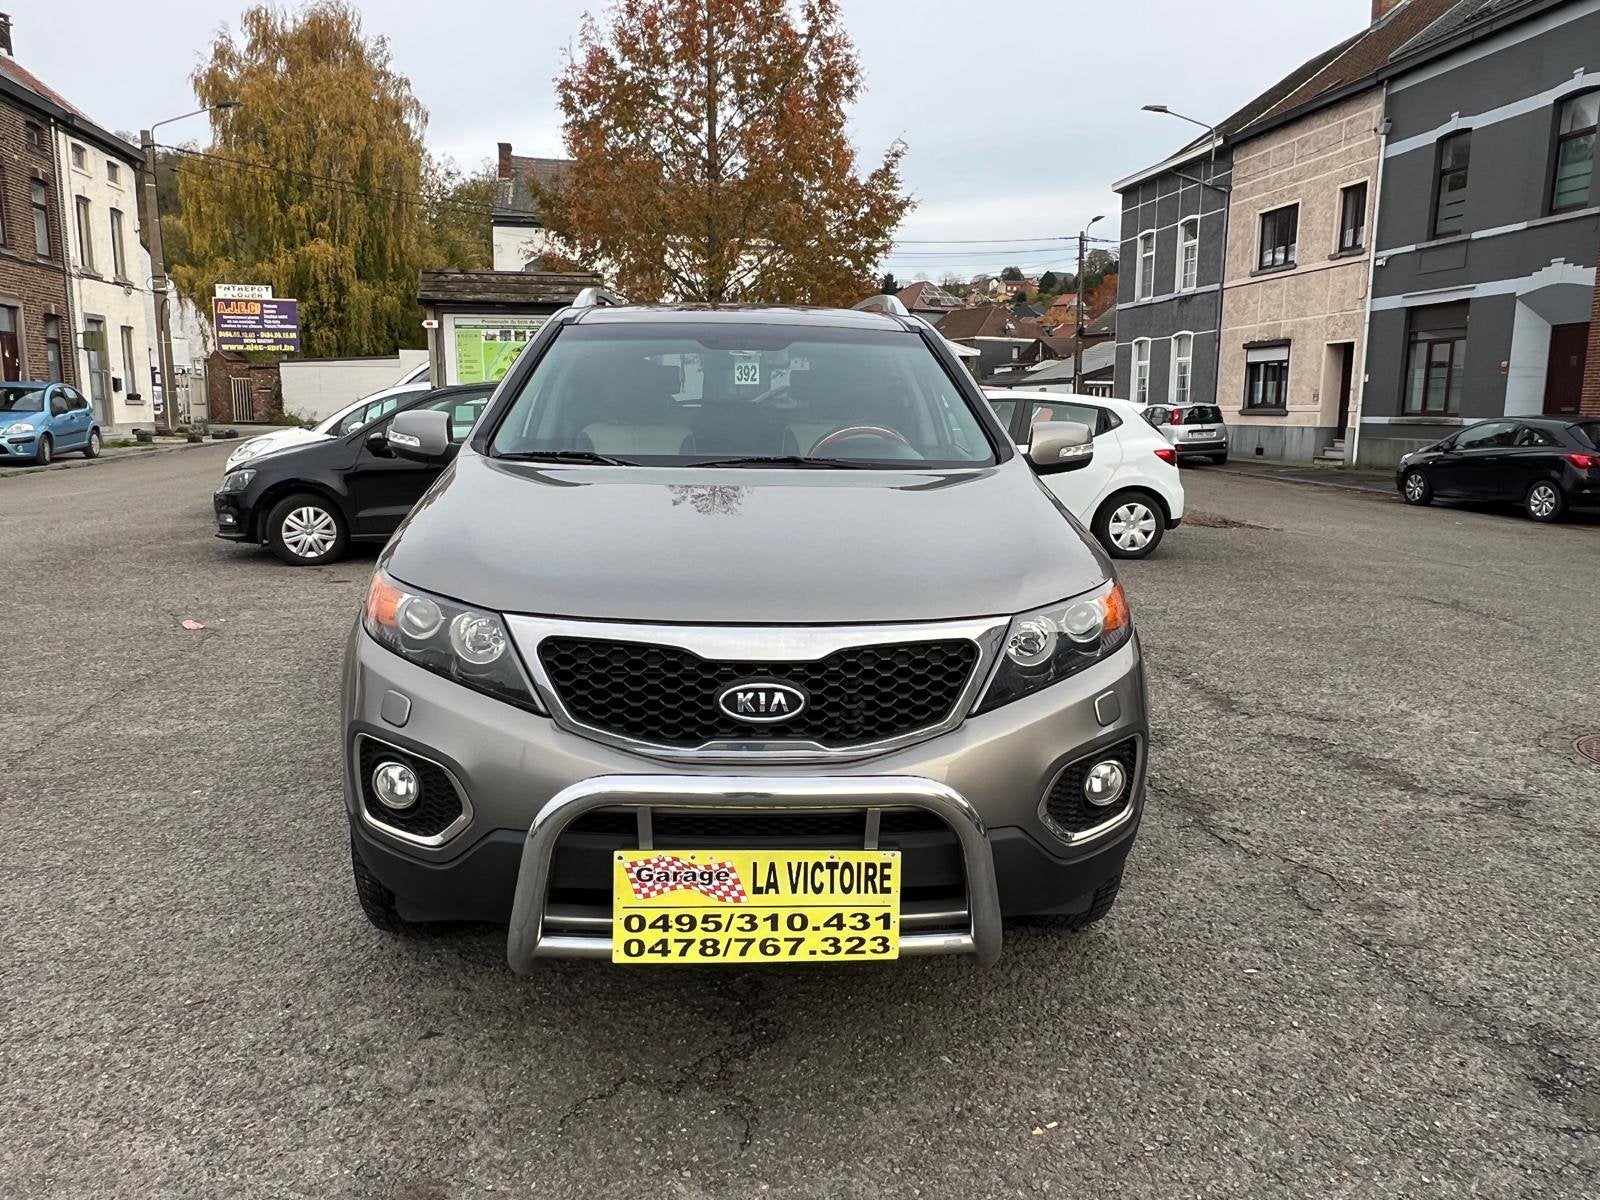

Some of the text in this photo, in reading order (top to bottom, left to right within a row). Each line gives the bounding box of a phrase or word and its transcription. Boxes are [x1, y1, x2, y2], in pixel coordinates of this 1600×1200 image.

[736, 365, 757, 382] 392
[736, 692, 789, 712] KIA
[635, 861, 892, 895] Garage LA VICTOIRE
[623, 912, 891, 933] 0495/310.431
[623, 935, 890, 957] 0478/767.323
